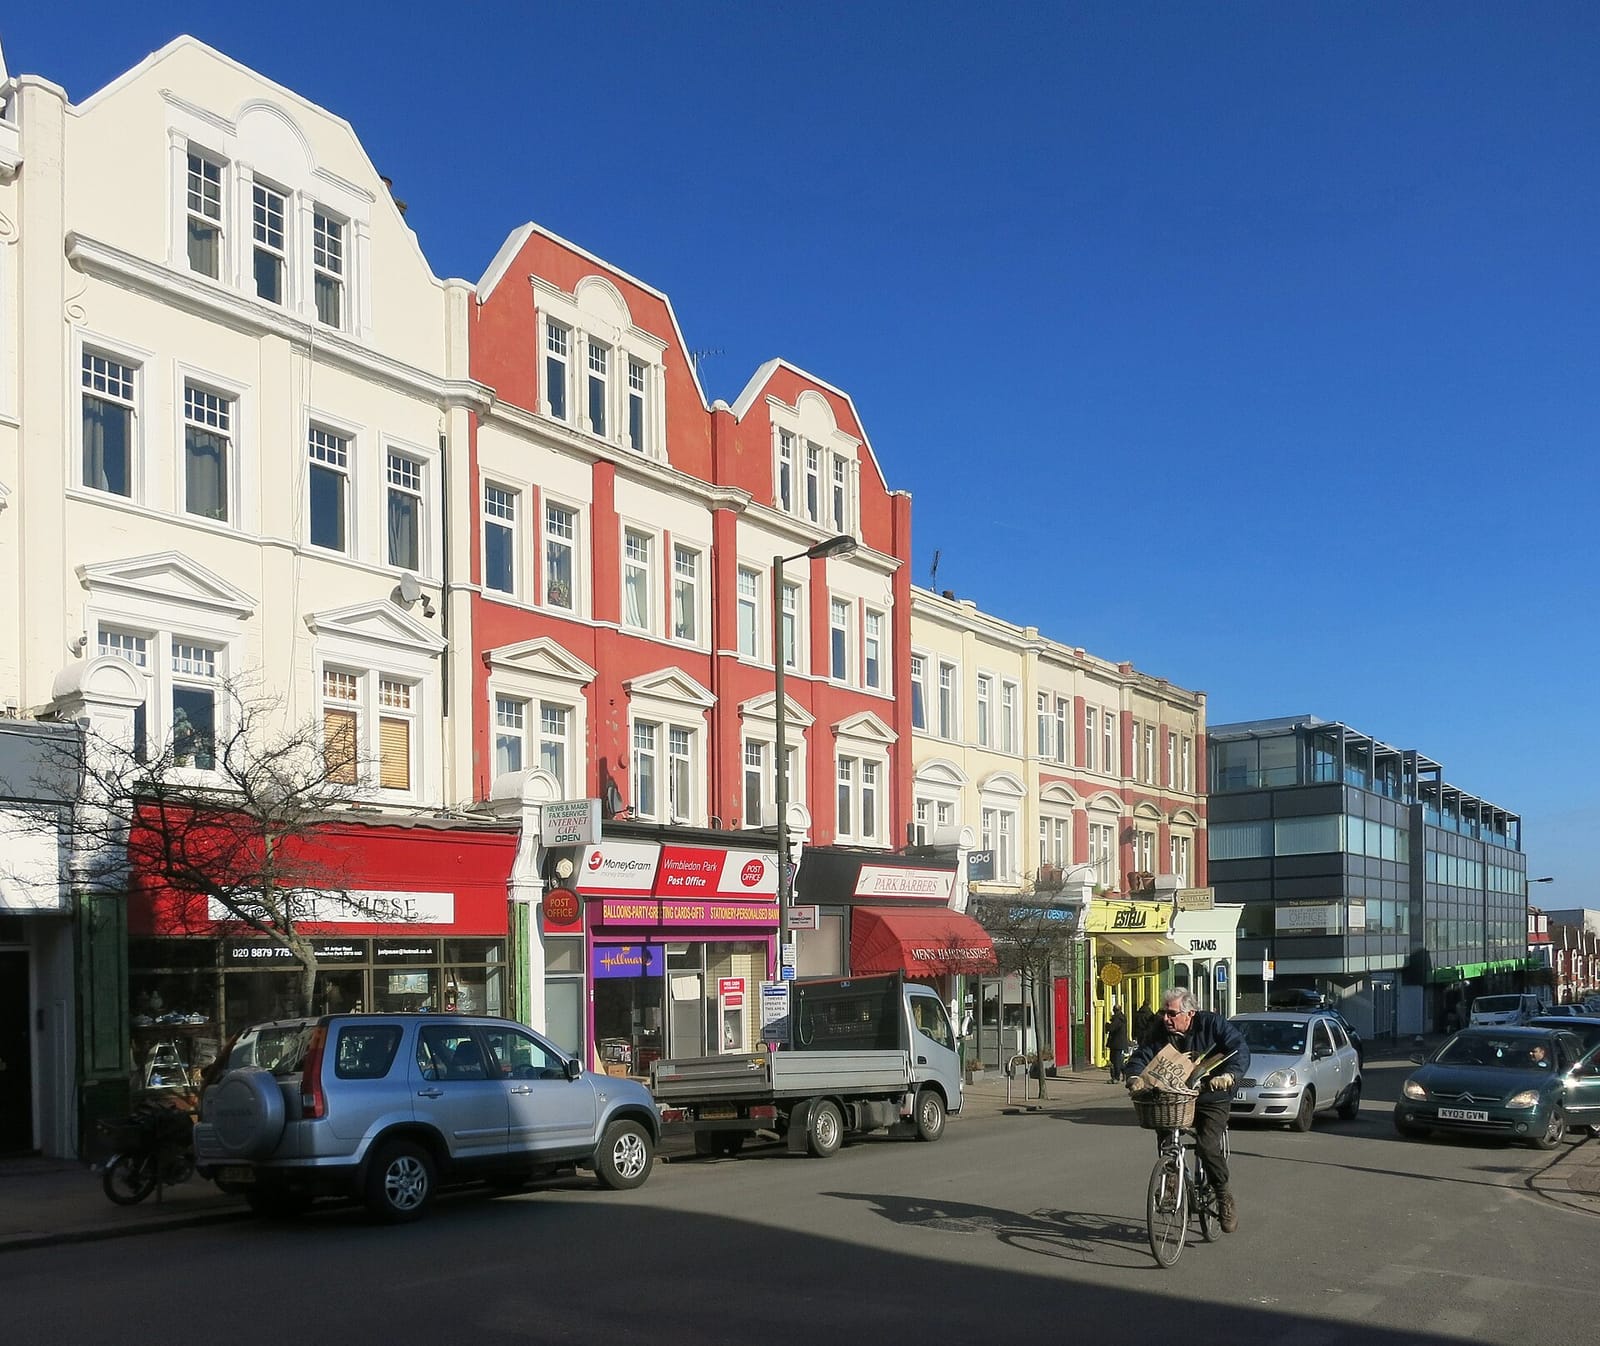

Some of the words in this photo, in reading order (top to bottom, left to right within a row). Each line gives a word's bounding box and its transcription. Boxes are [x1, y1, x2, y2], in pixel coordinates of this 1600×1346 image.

[546, 805, 565, 813] NEWS
[570, 802, 588, 810] MAGS
[562, 809, 587, 818] SERVICE
[548, 816, 588, 828] INTERNET
[557, 825, 578, 834] CAFE
[555, 833, 581, 843] OPEN
[603, 858, 651, 872] MoneyGram
[663, 858, 701, 871] Wimbledon
[702, 861, 718, 873] Park
[746, 865, 762, 873] POST
[667, 875, 683, 886] Post
[685, 876, 707, 887] Office
[741, 873, 762, 882] OFFICE
[874, 877, 897, 891] PARK
[899, 878, 938, 892] BARBERS
[337, 894, 419, 920] PAUSE
[550, 898, 570, 907] POST
[547, 907, 573, 917] OFFICE
[1114, 911, 1147, 926] ESTELLA
[1190, 939, 1217, 951] STRANDS
[232, 948, 249, 958] 020
[251, 948, 273, 958] 8879
[274, 947, 293, 957] 775
[911, 948, 936, 961] MEN'S
[1156, 1055, 1185, 1081] WHOL
[1441, 1109, 1465, 1119] KY03
